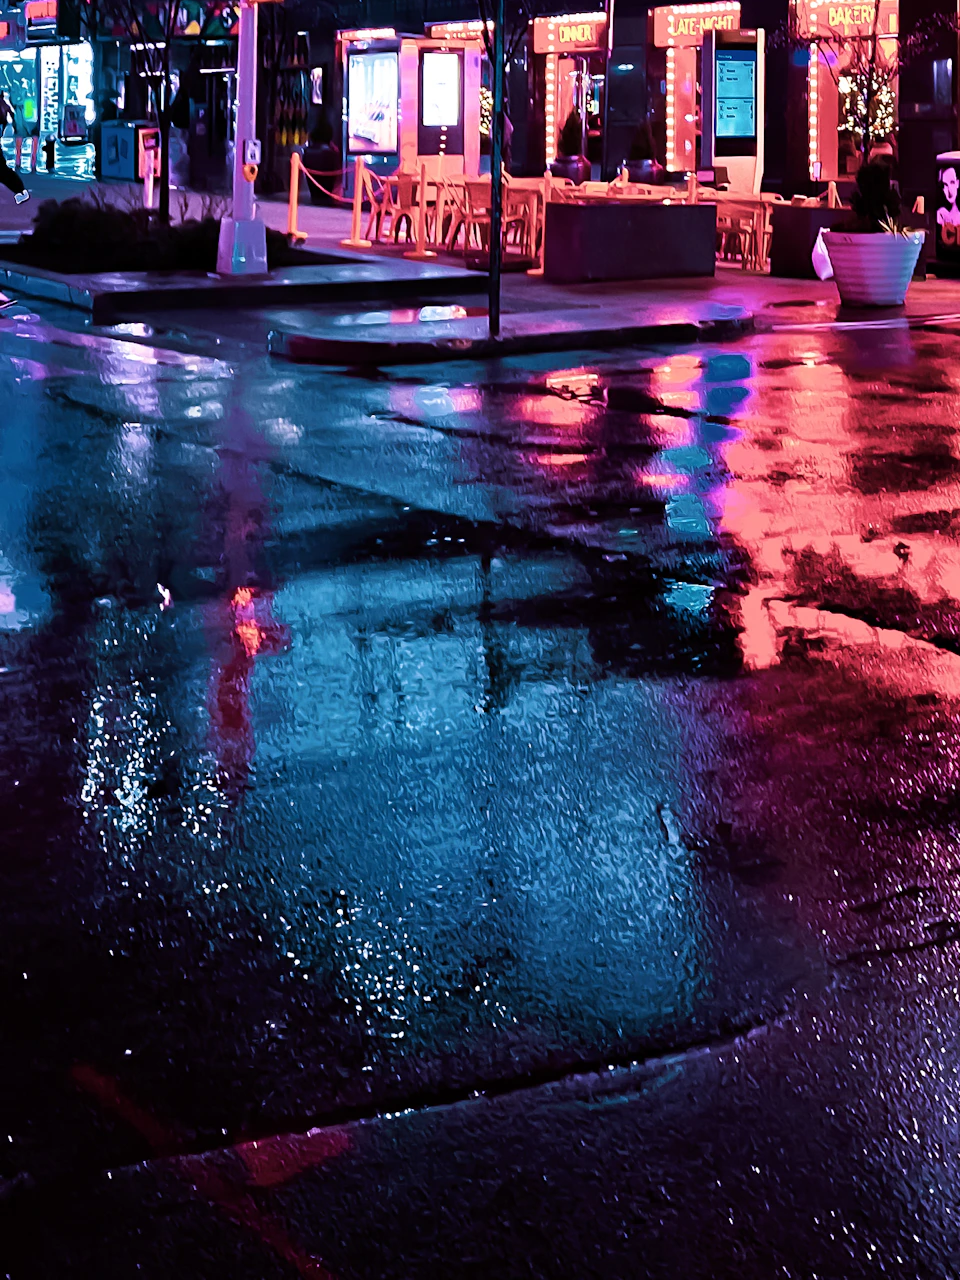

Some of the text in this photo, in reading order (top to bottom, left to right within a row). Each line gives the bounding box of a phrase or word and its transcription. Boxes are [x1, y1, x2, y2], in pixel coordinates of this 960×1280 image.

[670, 15, 735, 36] LATE-NIGHT
[828, 5, 877, 27] BAKERY
[559, 24, 593, 43] DINNER
